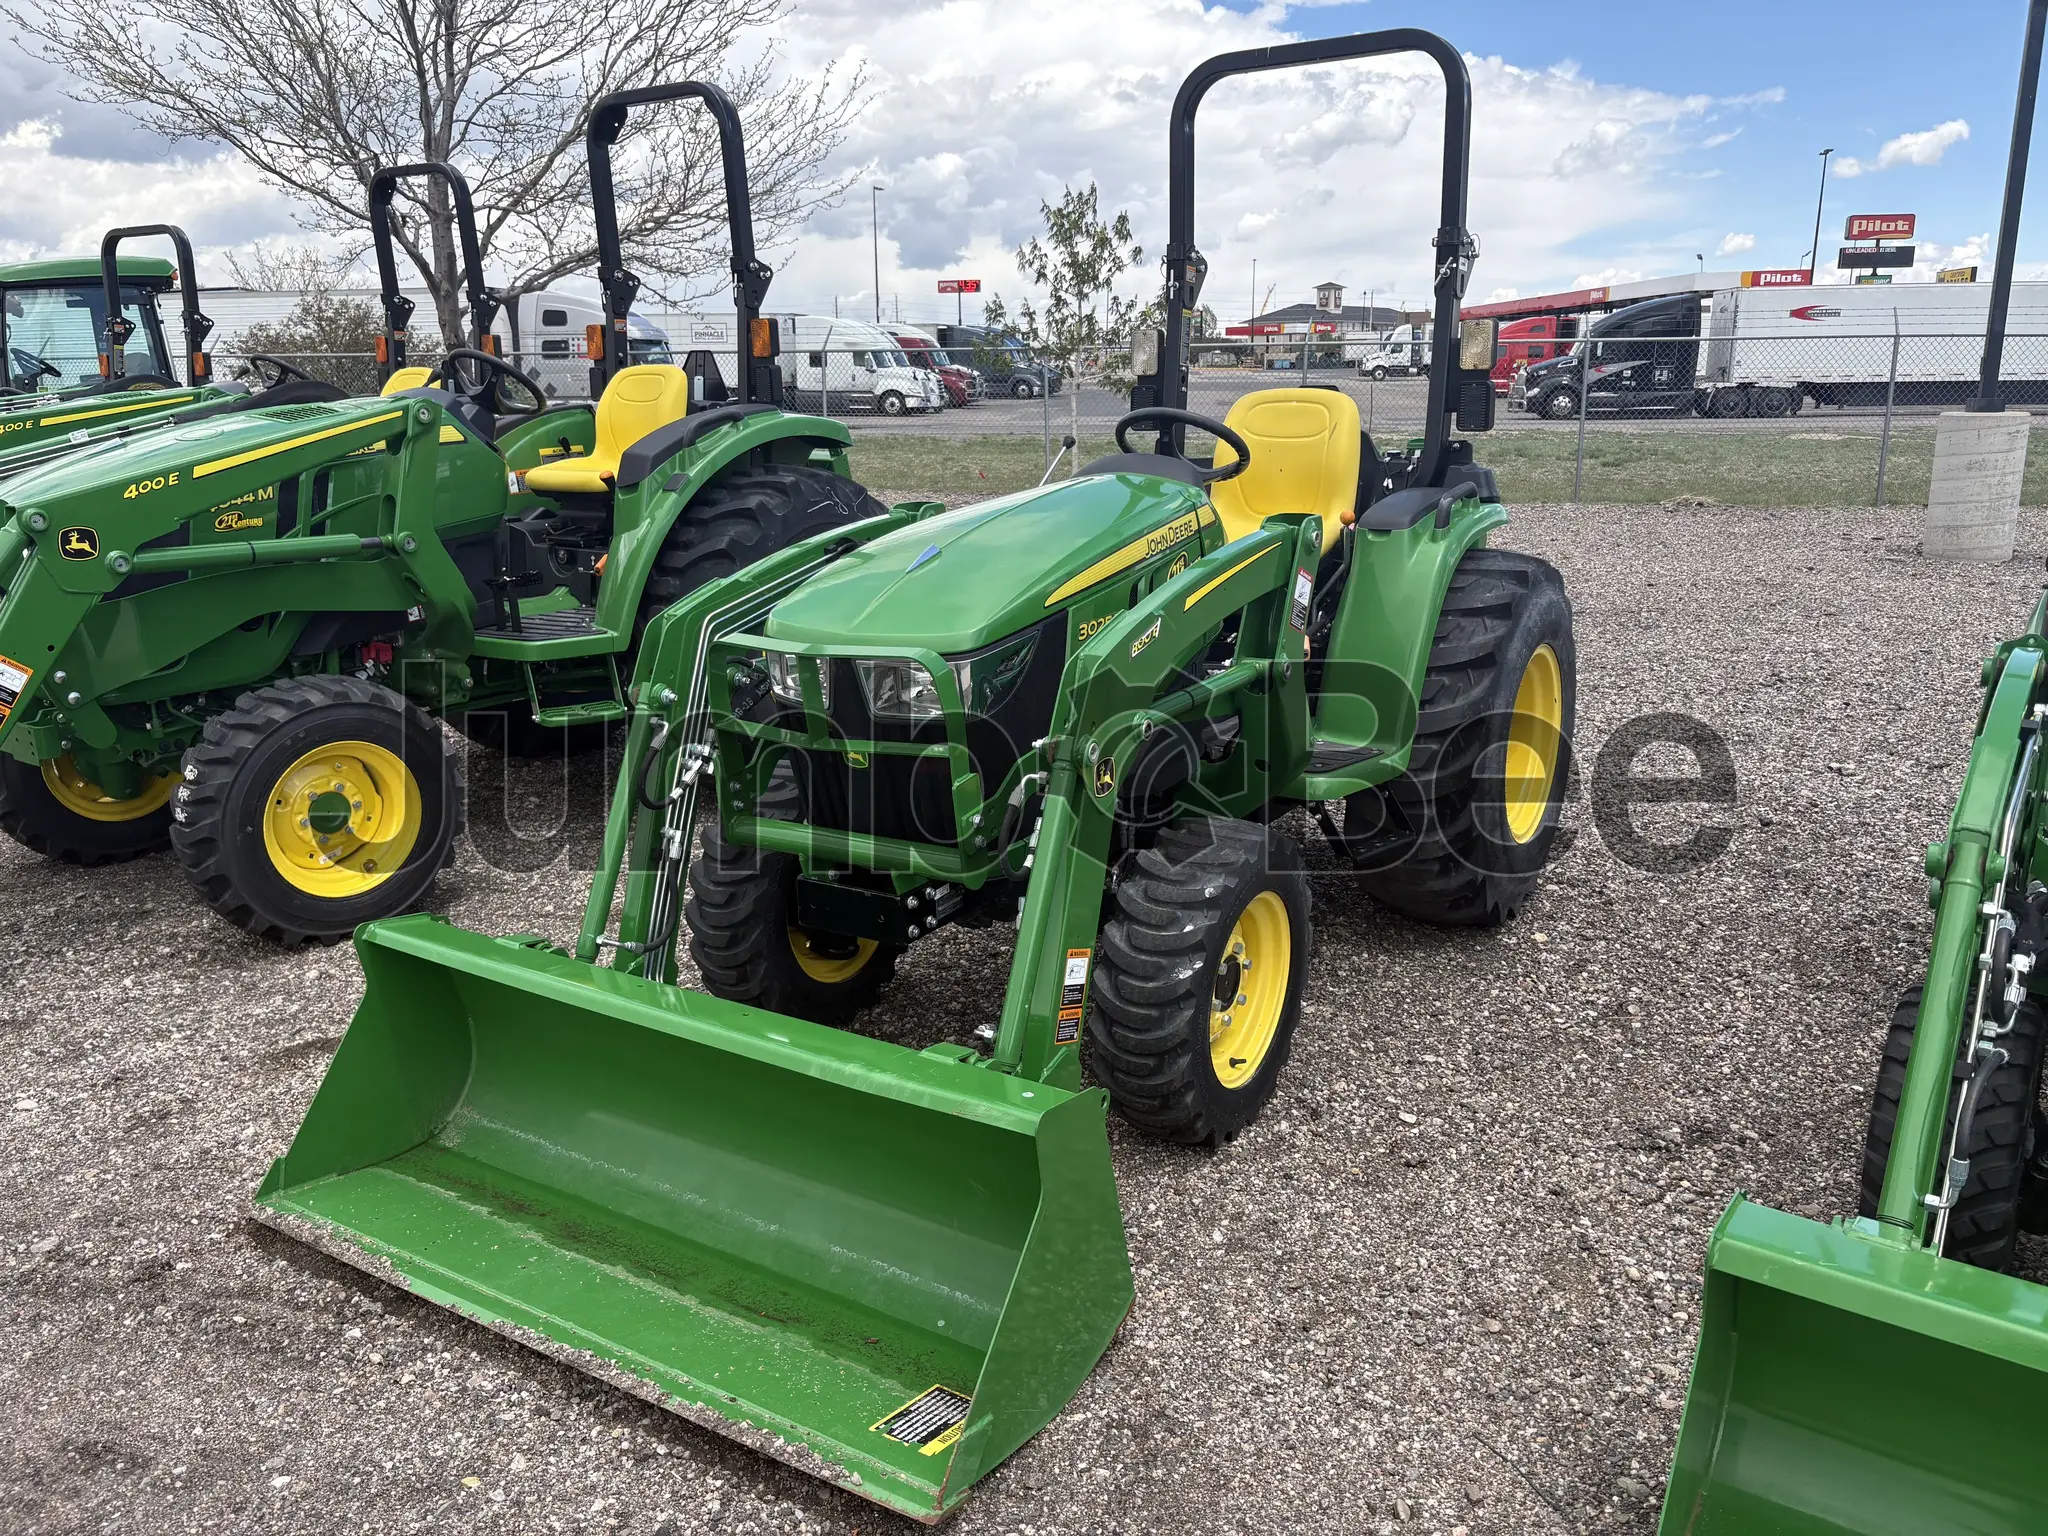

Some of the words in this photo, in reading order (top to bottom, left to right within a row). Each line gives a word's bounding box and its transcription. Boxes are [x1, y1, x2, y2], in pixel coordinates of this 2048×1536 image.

[1852, 220, 1910, 235] Pilot
[1760, 273, 1802, 285] Pilot
[26, 420, 33, 429] E
[123, 476, 165, 499] 400
[168, 471, 180, 486] E
[258, 485, 274, 501] M
[1168, 520, 1193, 545] DEERE
